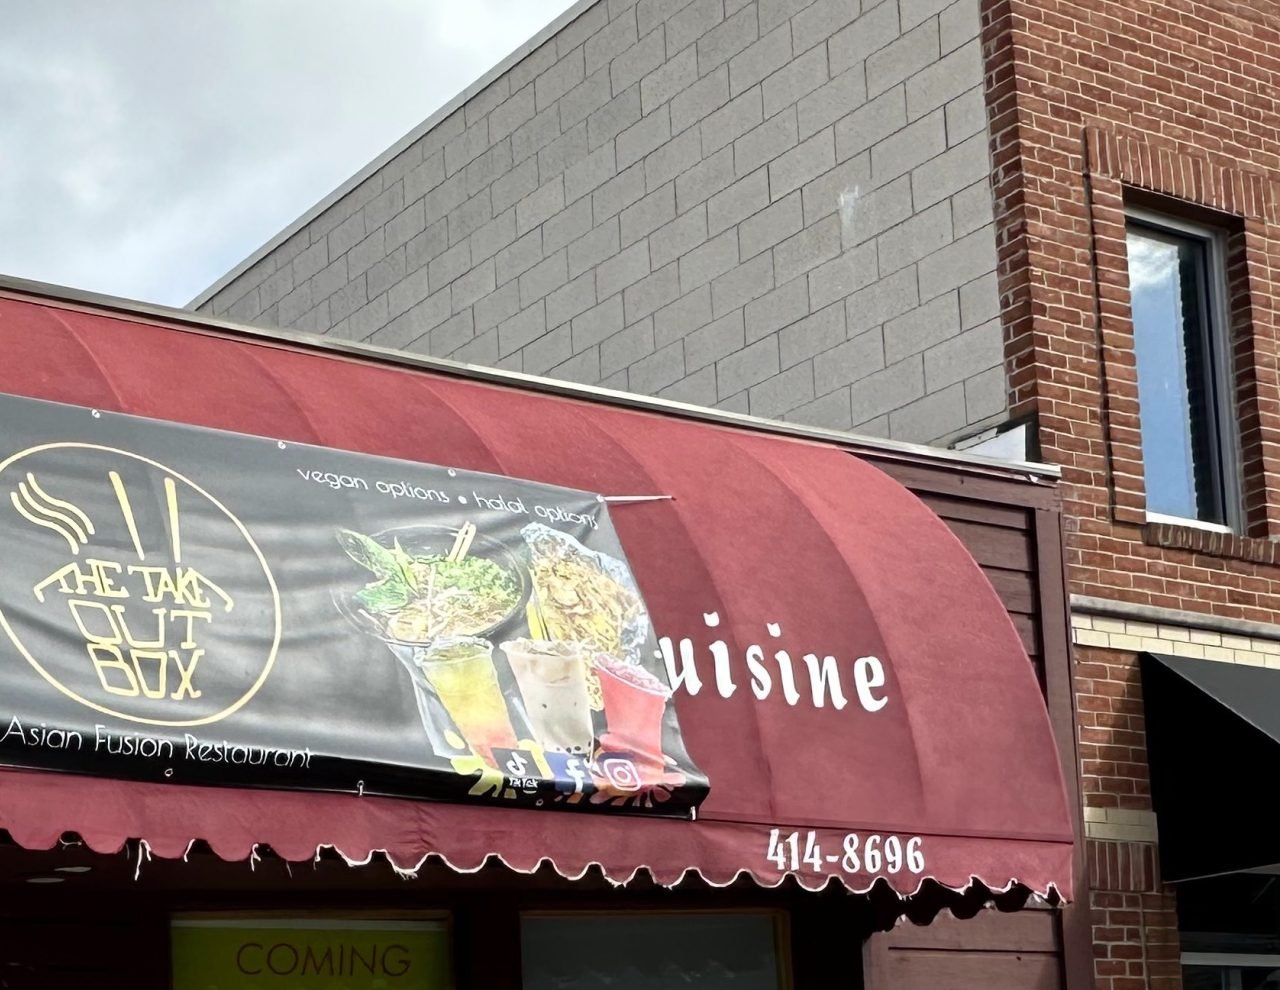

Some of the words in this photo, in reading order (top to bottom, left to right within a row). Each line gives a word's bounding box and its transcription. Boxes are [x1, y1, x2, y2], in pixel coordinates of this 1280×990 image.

[296, 467, 368, 489] vegan
[375, 478, 450, 504] options
[472, 490, 529, 515] halal
[33, 558, 130, 603] THE
[68, 598, 213, 650] OUT
[86, 642, 206, 700] BOX
[658, 610, 889, 713] uisine
[0, 715, 83, 750] Asian
[94, 724, 174, 759] Fusion
[184, 733, 313, 769] Restaurant
[766, 828, 925, 874] 414-8696
[236, 942, 412, 978] COMING
